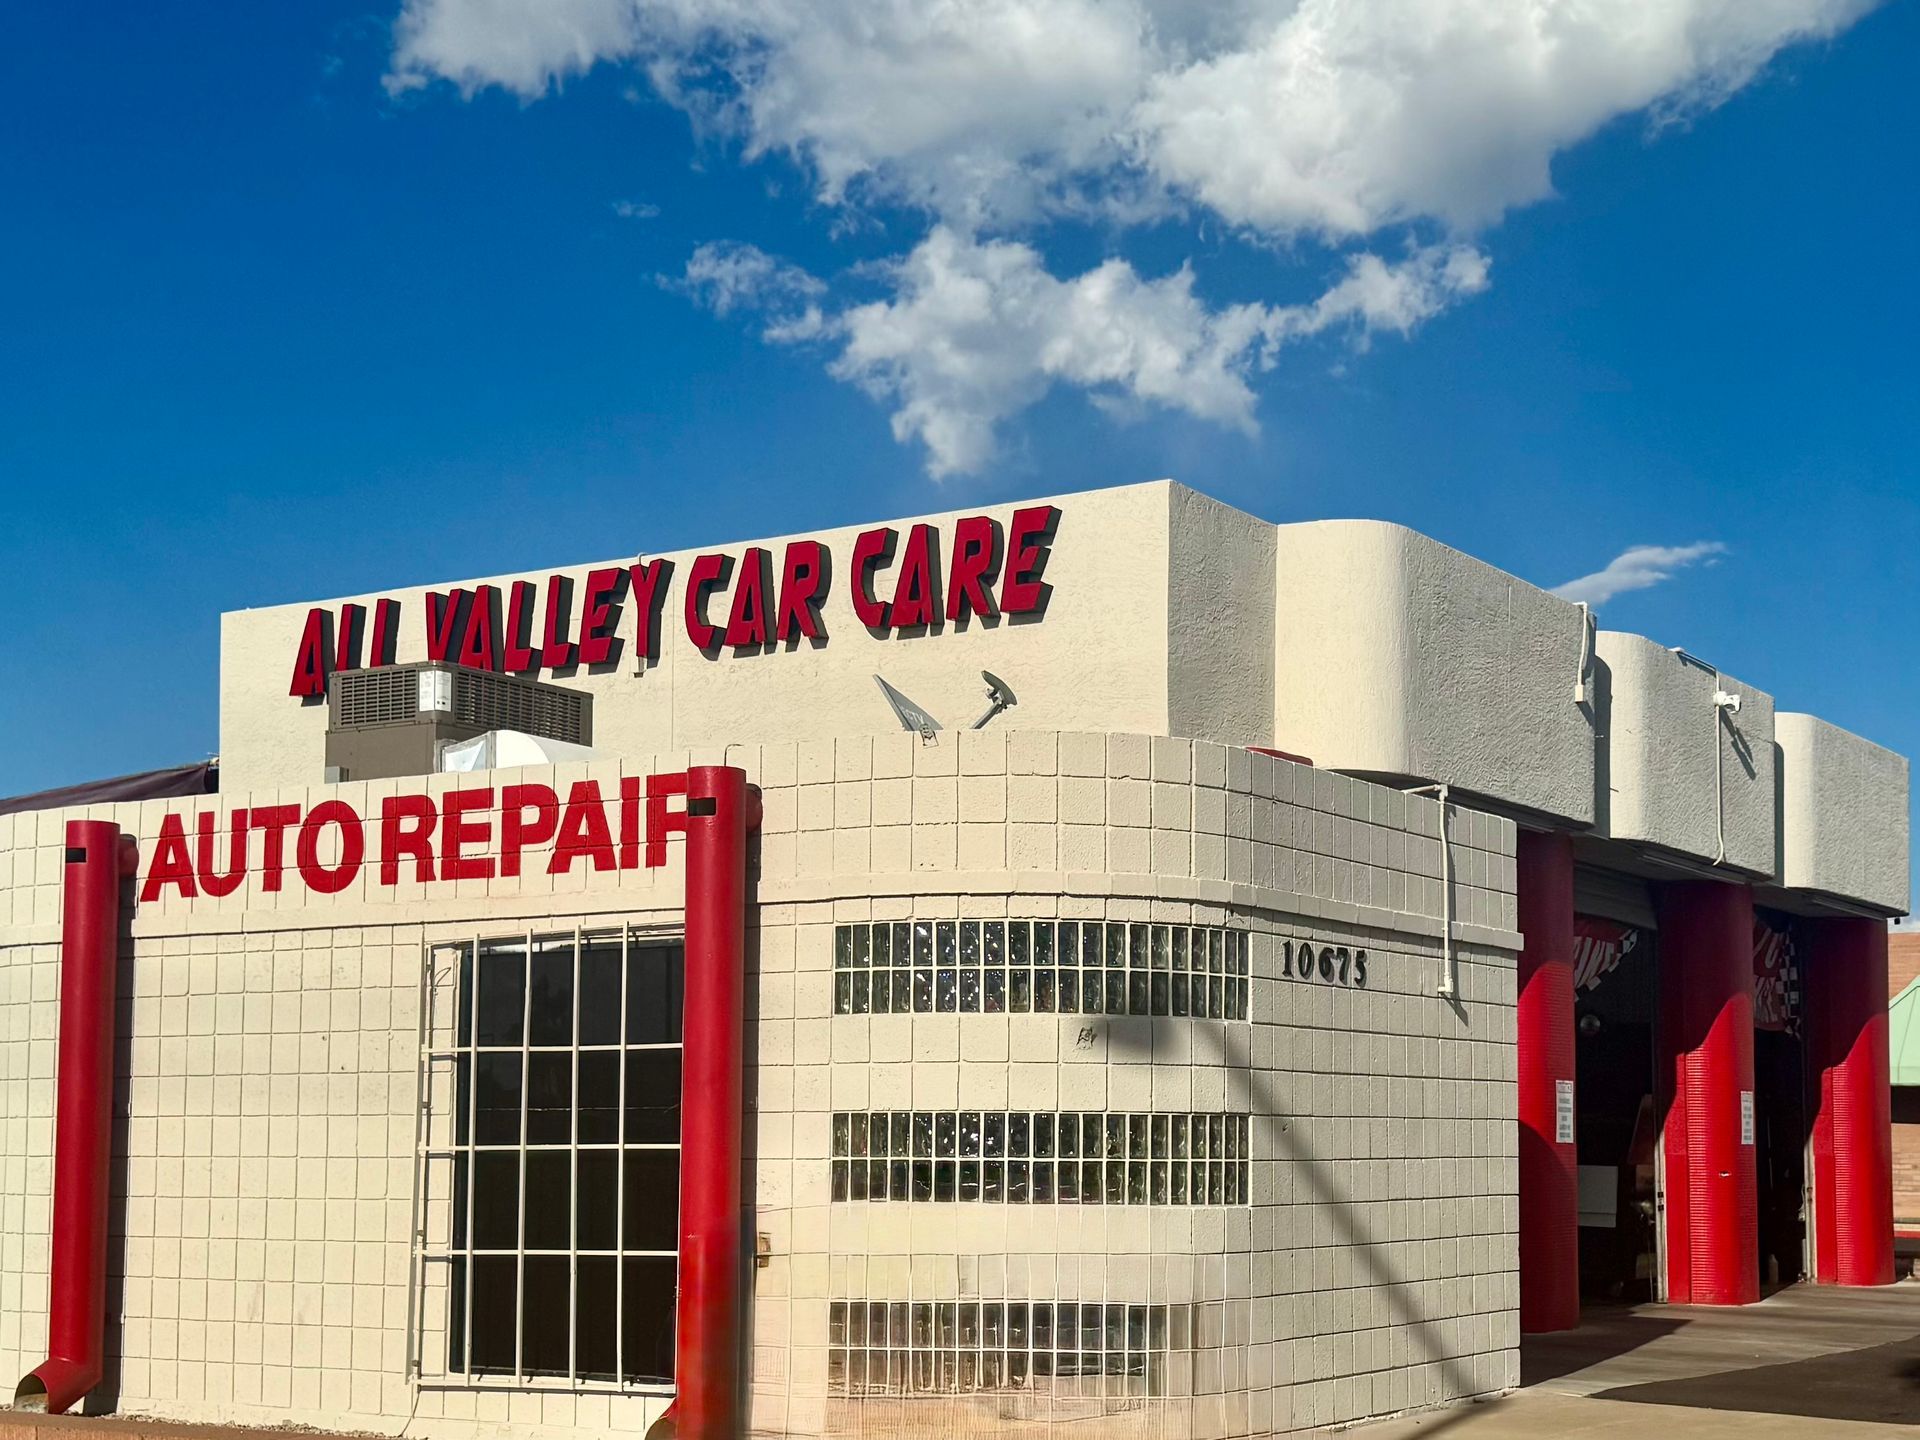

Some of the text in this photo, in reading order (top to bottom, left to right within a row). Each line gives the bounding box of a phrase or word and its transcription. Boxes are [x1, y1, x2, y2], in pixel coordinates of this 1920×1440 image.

[425, 559, 668, 675] VALLEY
[684, 541, 829, 653] CAR
[851, 506, 1058, 632] CARE
[139, 800, 364, 902] AUTO
[1281, 940, 1367, 988] 10675
